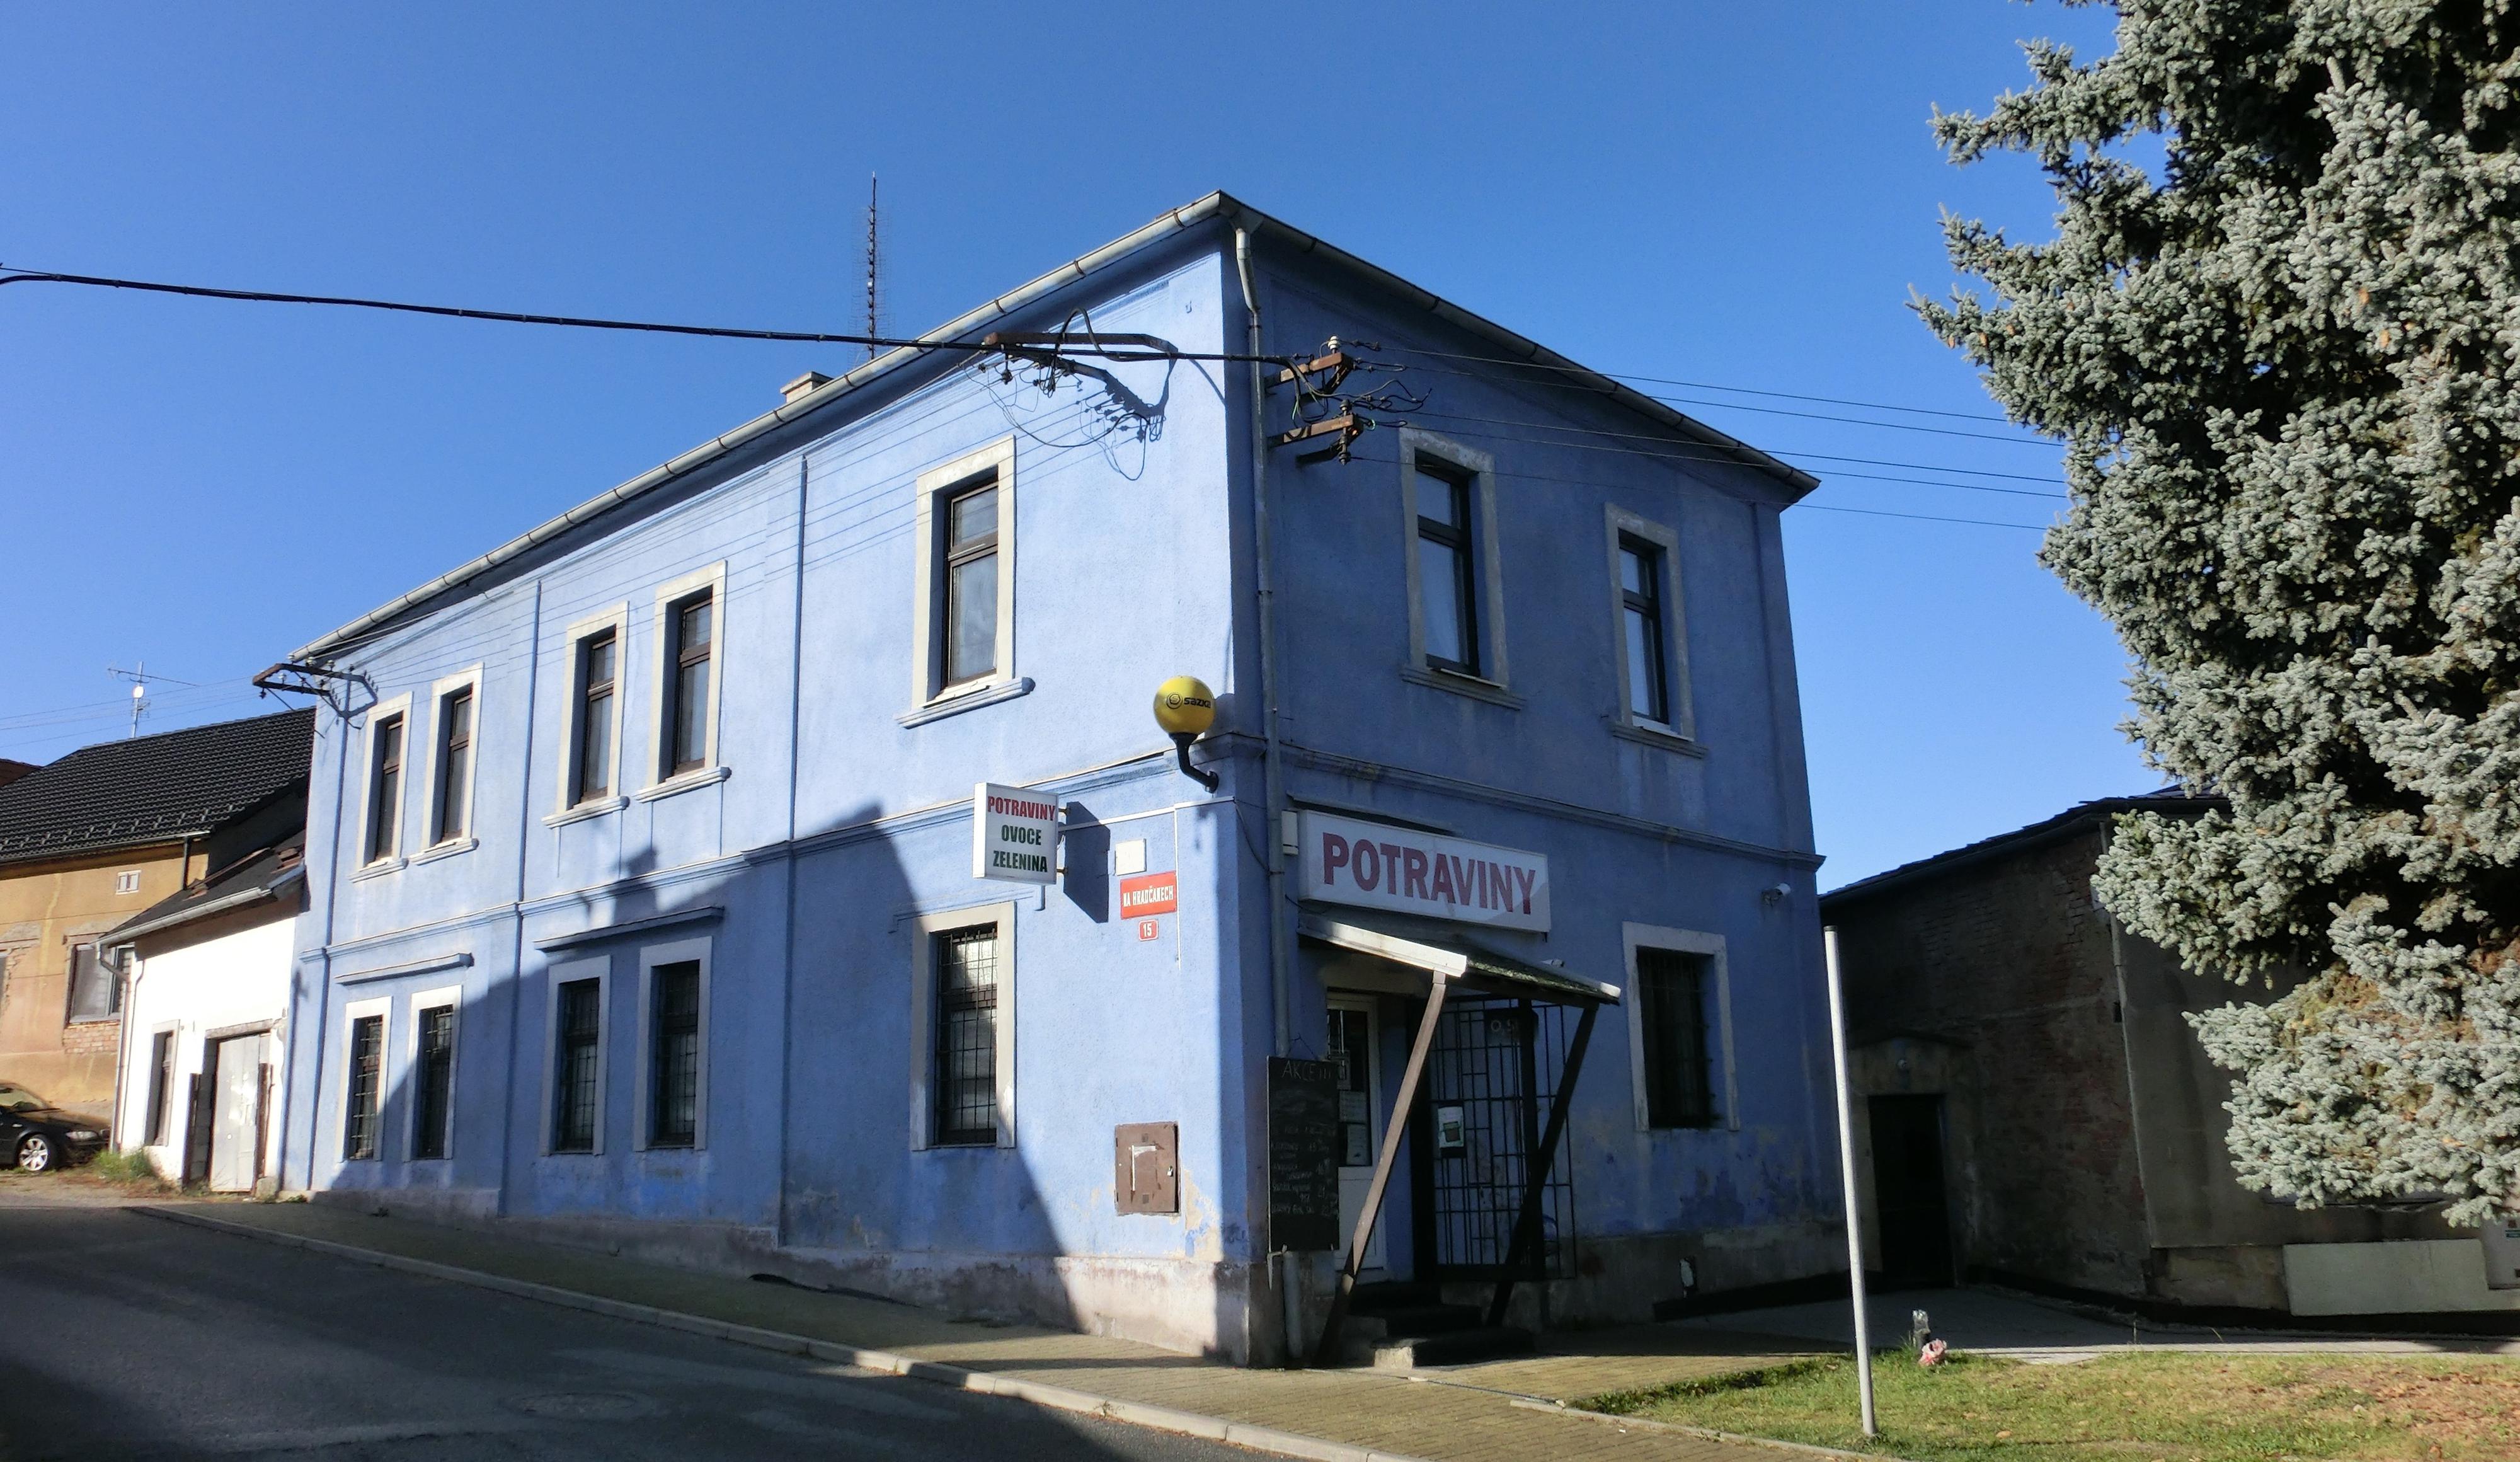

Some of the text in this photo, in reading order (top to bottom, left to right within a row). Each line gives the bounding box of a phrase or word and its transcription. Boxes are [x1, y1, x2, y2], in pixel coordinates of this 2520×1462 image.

[987, 796, 1056, 821] POTRAVINY
[1001, 824, 1042, 846] OVOCE
[993, 850, 1048, 872] ZELENINA
[1323, 832, 1536, 915] POTRAVINY
[1123, 885, 1174, 907] NA HRADČANECH
[1143, 923, 1152, 938] 15
